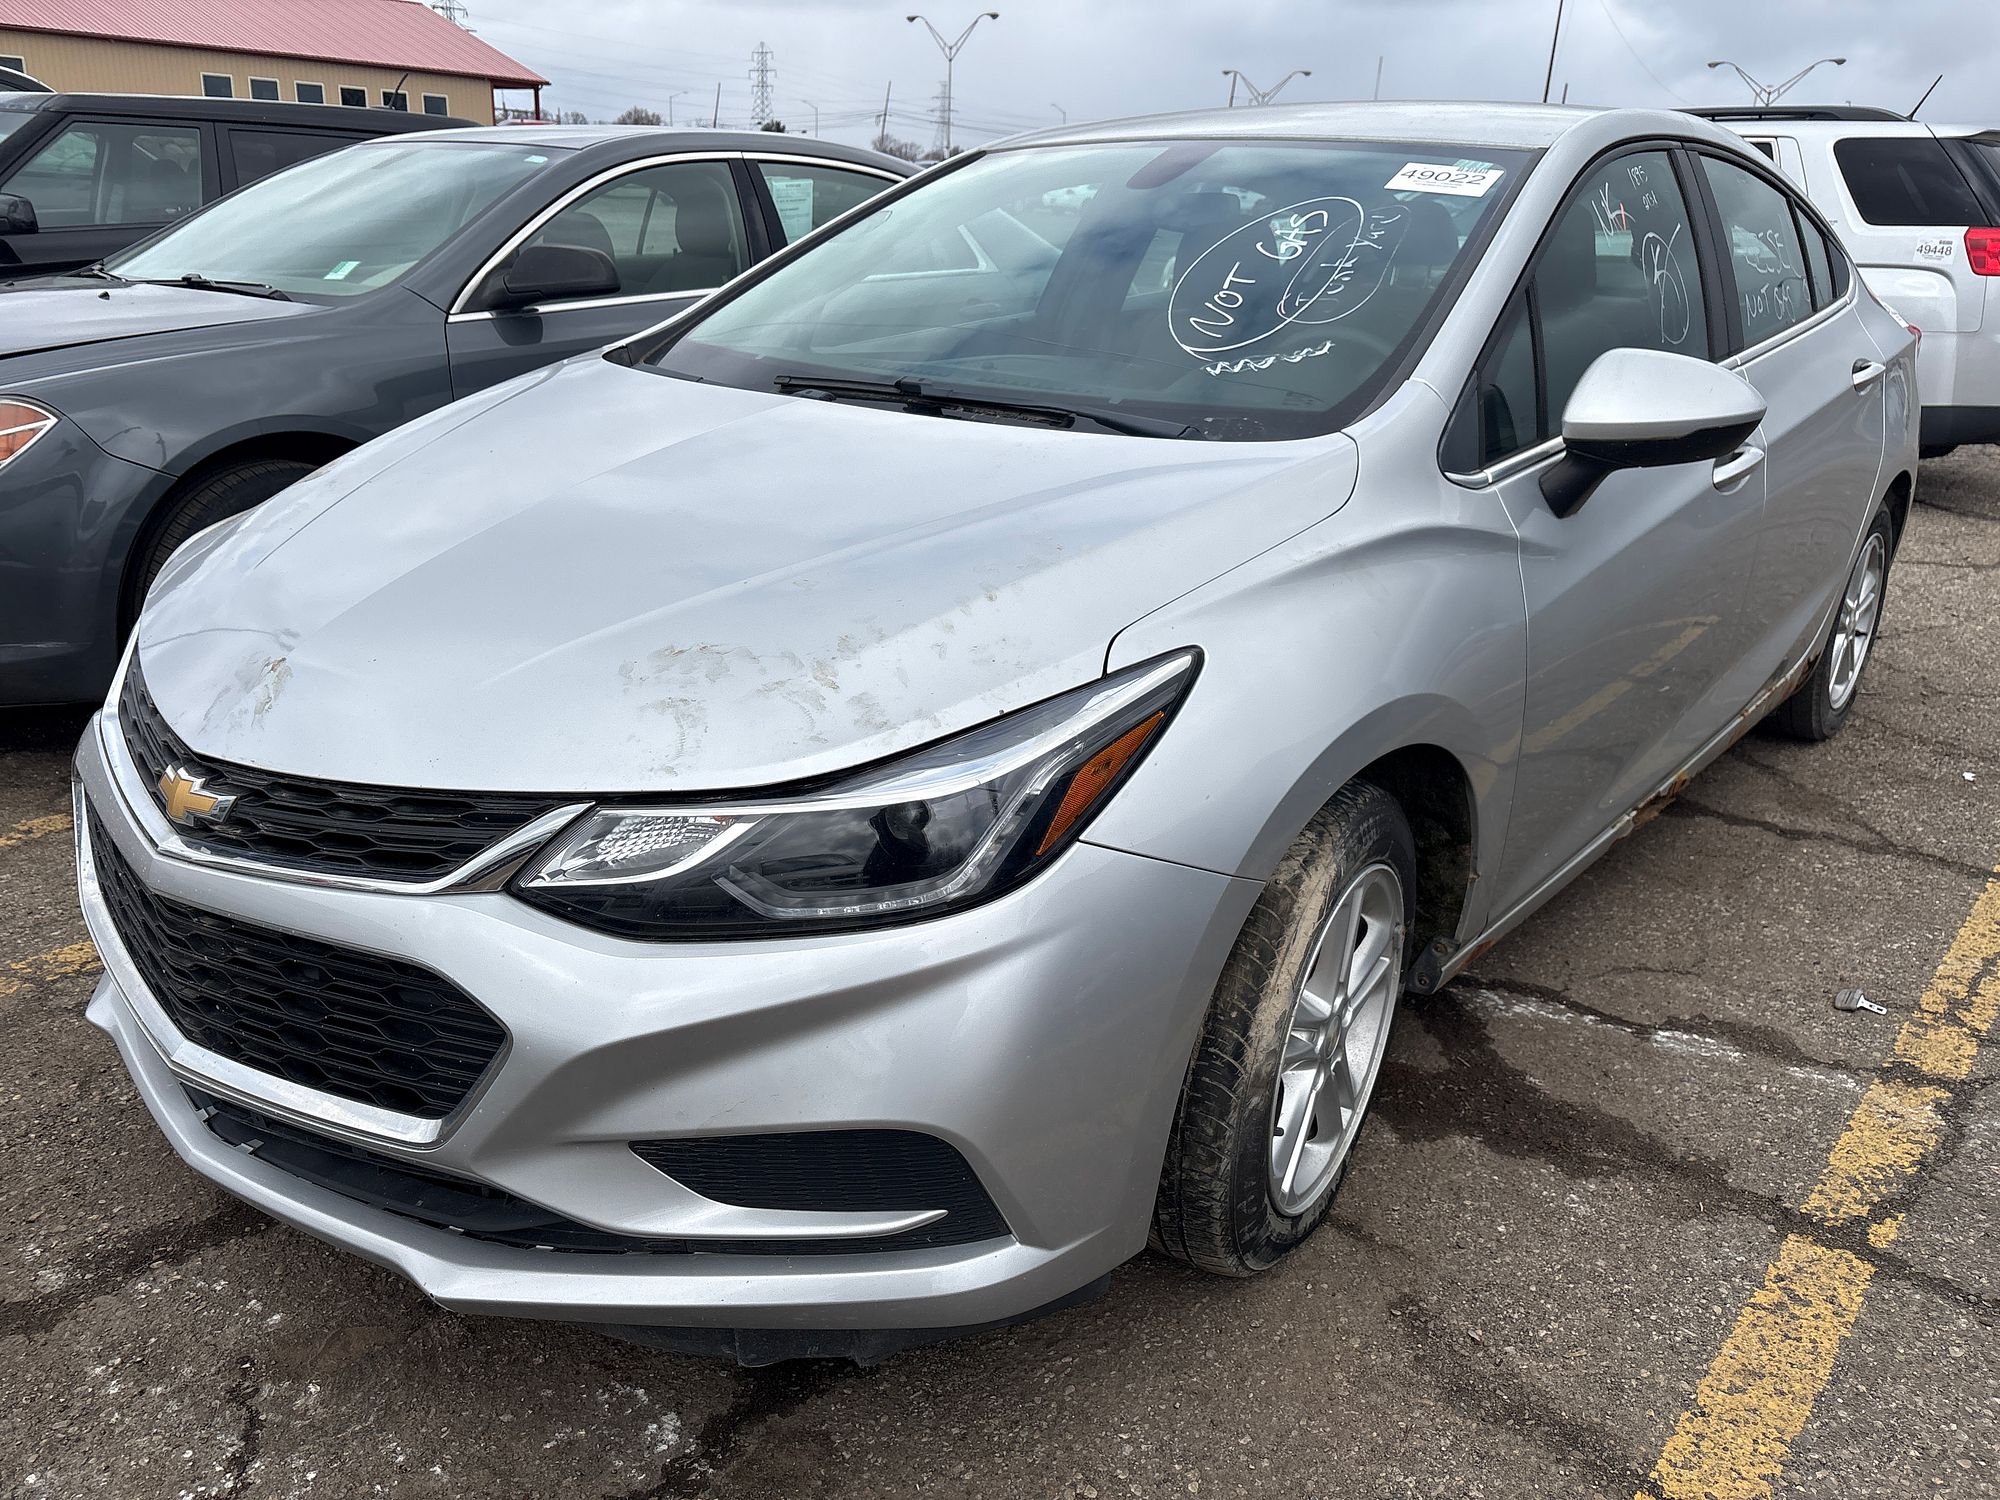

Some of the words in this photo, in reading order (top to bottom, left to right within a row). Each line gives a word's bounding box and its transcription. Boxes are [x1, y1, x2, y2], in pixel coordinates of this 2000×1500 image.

[1401, 169, 1486, 185] 49022
[1916, 244, 1953, 256] 49448
[1188, 261, 1256, 338] NOT
[1256, 209, 1329, 260] GAS
[1745, 283, 1770, 327] NOT
